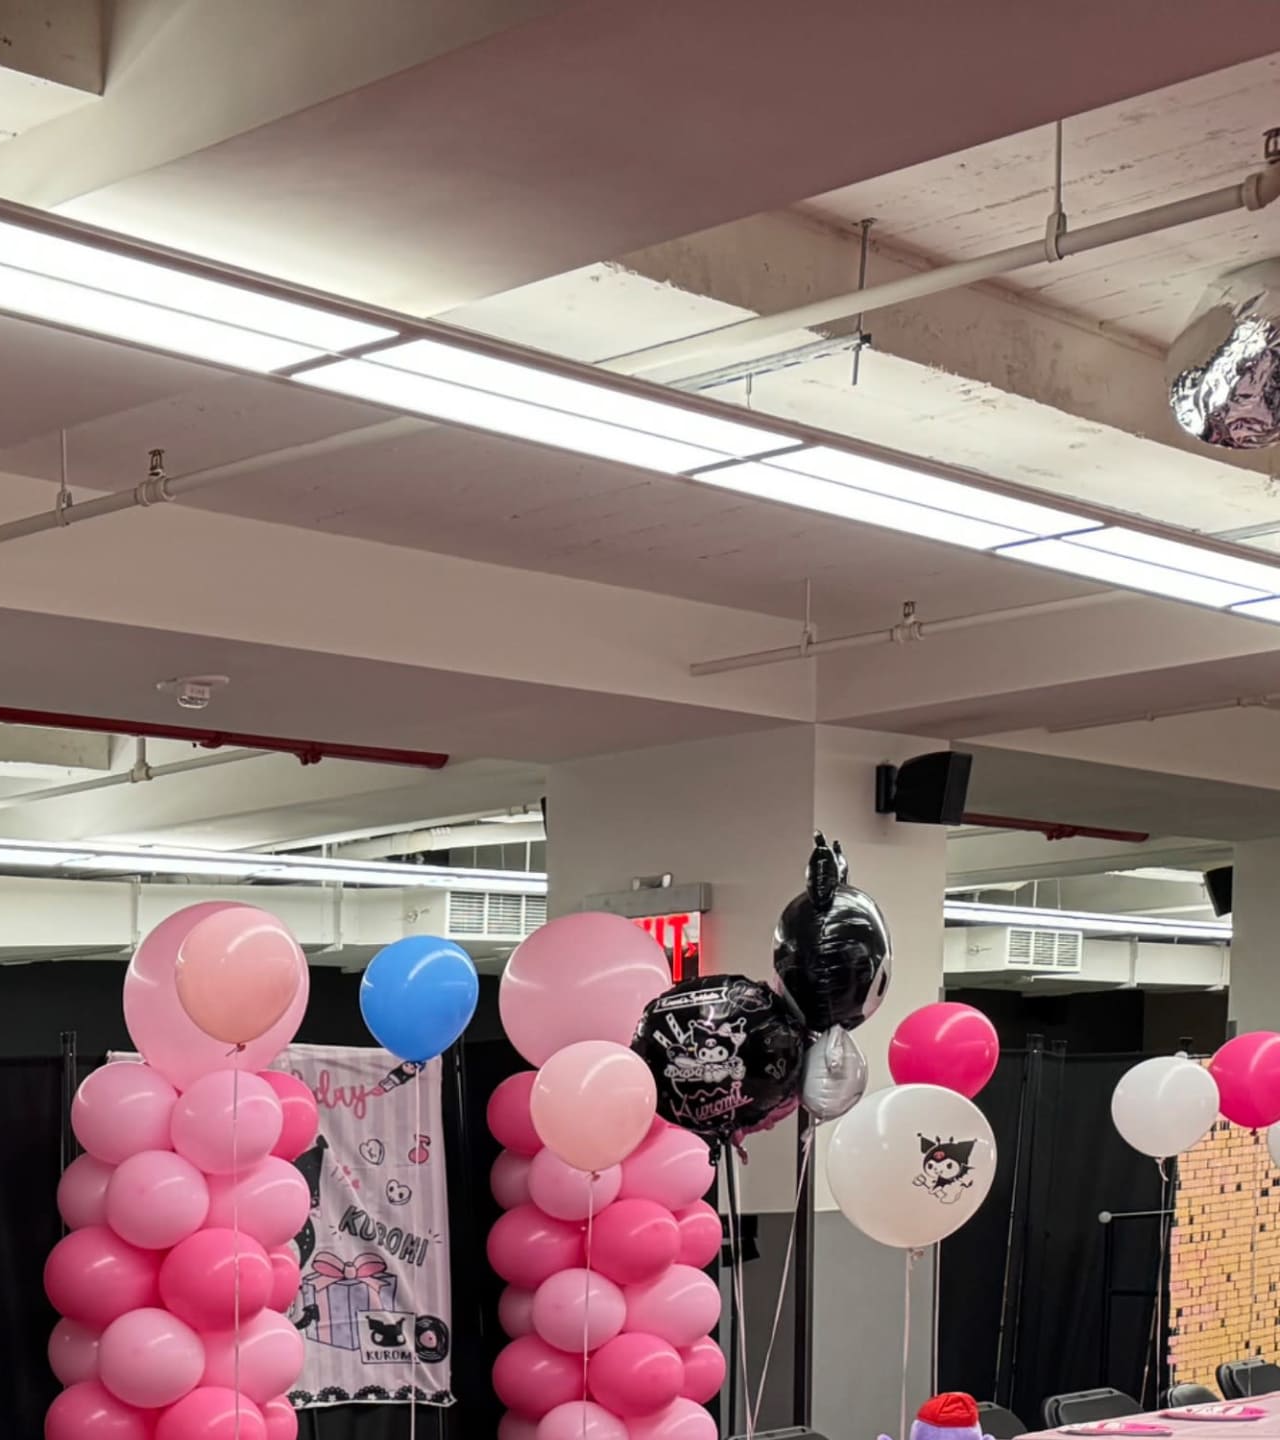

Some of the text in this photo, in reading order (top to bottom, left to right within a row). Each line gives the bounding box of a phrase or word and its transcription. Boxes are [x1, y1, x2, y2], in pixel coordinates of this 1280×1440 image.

[291, 1068, 368, 1120] day
[339, 1206, 428, 1266] KUROMI
[366, 1350, 417, 1361] KUROM
